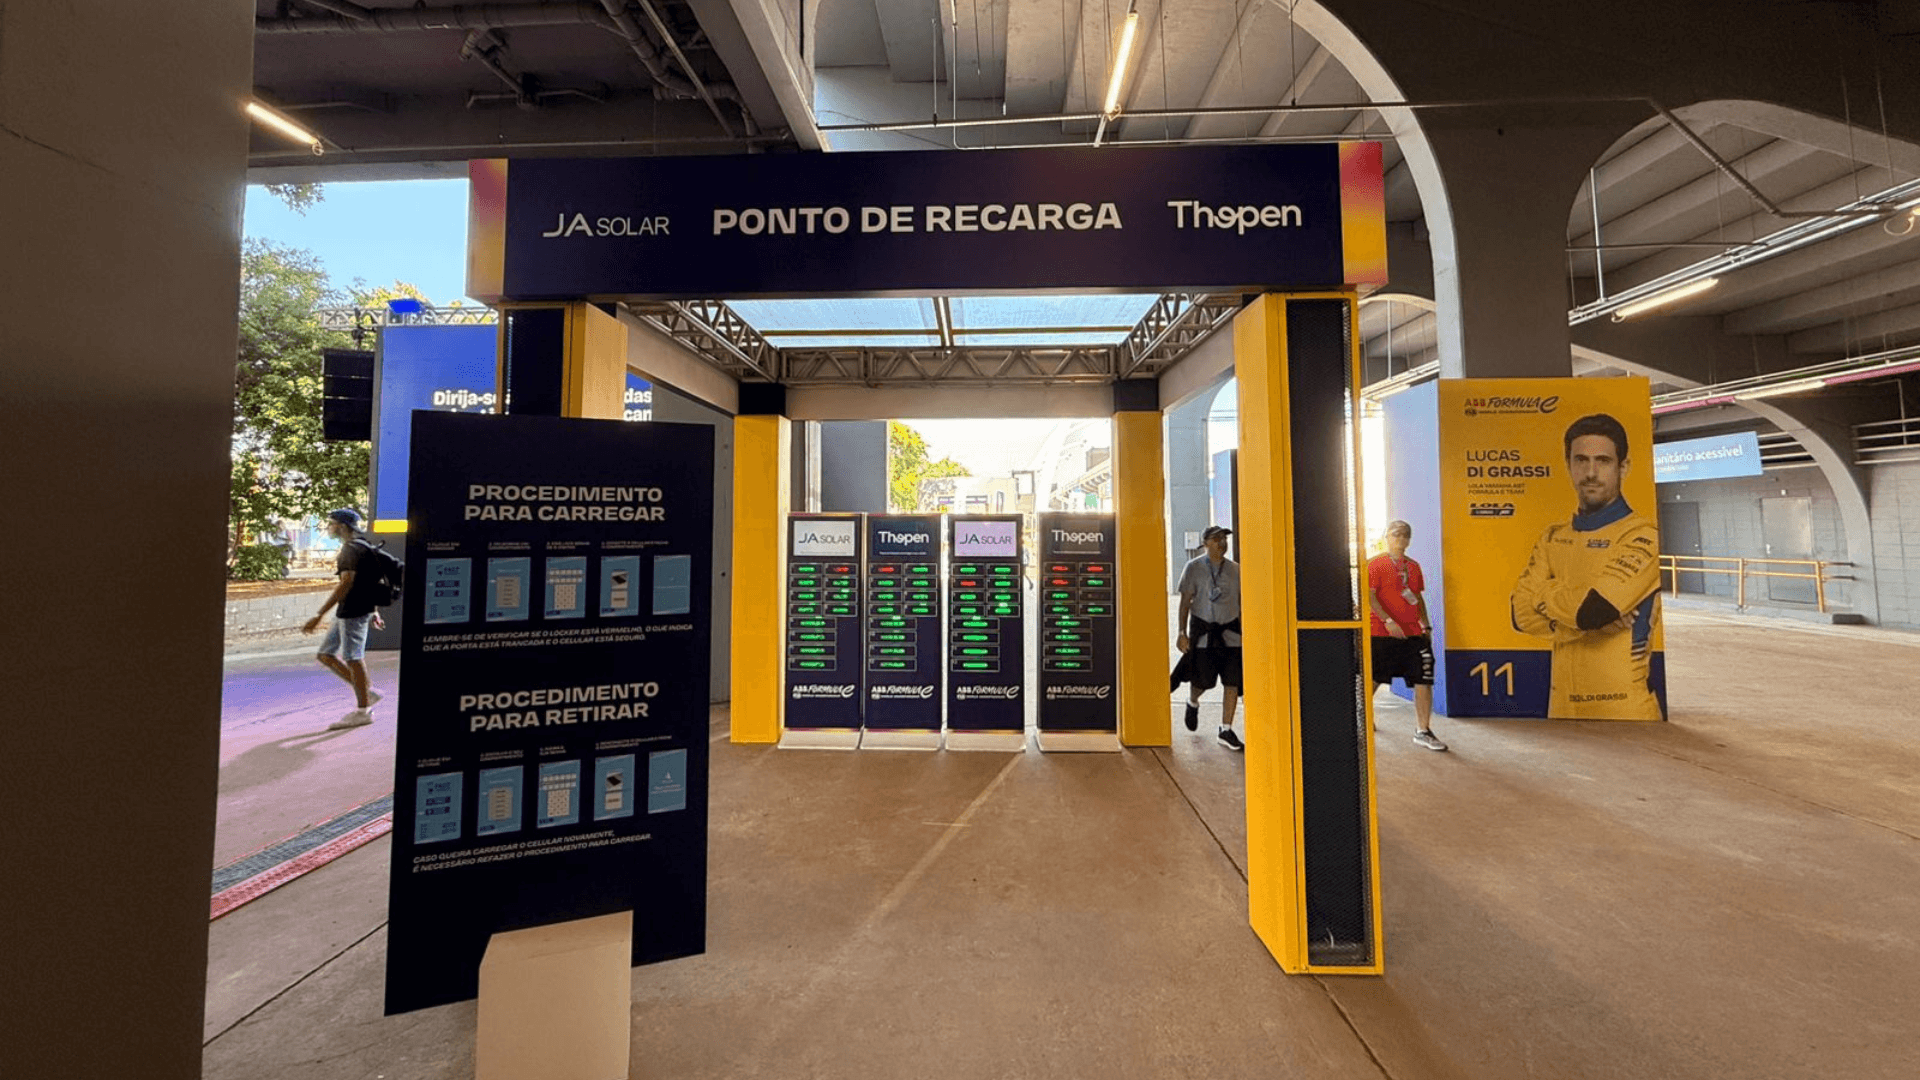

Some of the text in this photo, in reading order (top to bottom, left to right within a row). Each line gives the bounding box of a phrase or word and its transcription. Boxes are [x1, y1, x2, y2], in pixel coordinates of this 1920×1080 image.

[543, 213, 670, 238] JA SOLAR
[713, 203, 1123, 236] PONTO DE RECARGA
[1465, 398, 1485, 407] ABB
[1487, 396, 1540, 409] FORMULA
[1466, 450, 1520, 461] LUCAS
[1653, 449, 1694, 467] anitário
[1467, 466, 1550, 478] DI GRASSI
[468, 484, 663, 502] PROCEDIMENTO
[464, 505, 665, 521] PARA CARREGAR
[798, 532, 851, 544] JA SOLAR
[959, 533, 1012, 545] JA SOLAR
[474, 633, 487, 641] DE
[487, 631, 530, 640] VERIFICAR
[531, 630, 542, 638] SE
[550, 628, 580, 637] LOCKER
[580, 626, 600, 636] ESTÁ
[645, 625, 652, 633] O
[652, 625, 668, 633] QUE
[668, 624, 694, 632] INDICA
[422, 643, 442, 653] QUE
[442, 643, 450, 651] A
[450, 641, 479, 651] PORTA
[479, 639, 500, 650] ESTÁ
[501, 639, 546, 648] TRANCADA
[552, 638, 559, 646] O
[559, 636, 595, 645] CELULAR
[595, 634, 614, 643] ESTÁ
[1470, 661, 1515, 696] 11
[459, 681, 659, 712] PROCEDIMENTO
[470, 703, 649, 732] PARA RETIRAR
[412, 853, 438, 864] CASO
[438, 849, 472, 861] QUEIRA
[472, 843, 518, 856] CARREGAR
[519, 842, 526, 850] O
[527, 837, 564, 849] CELULAR
[412, 864, 420, 874] É
[420, 857, 476, 872] NECESSÁRIO
[476, 852, 516, 864] REFAZER
[516, 850, 524, 859] O
[524, 842, 588, 857] PROCEDIMENTO
[588, 839, 610, 849] PARA
